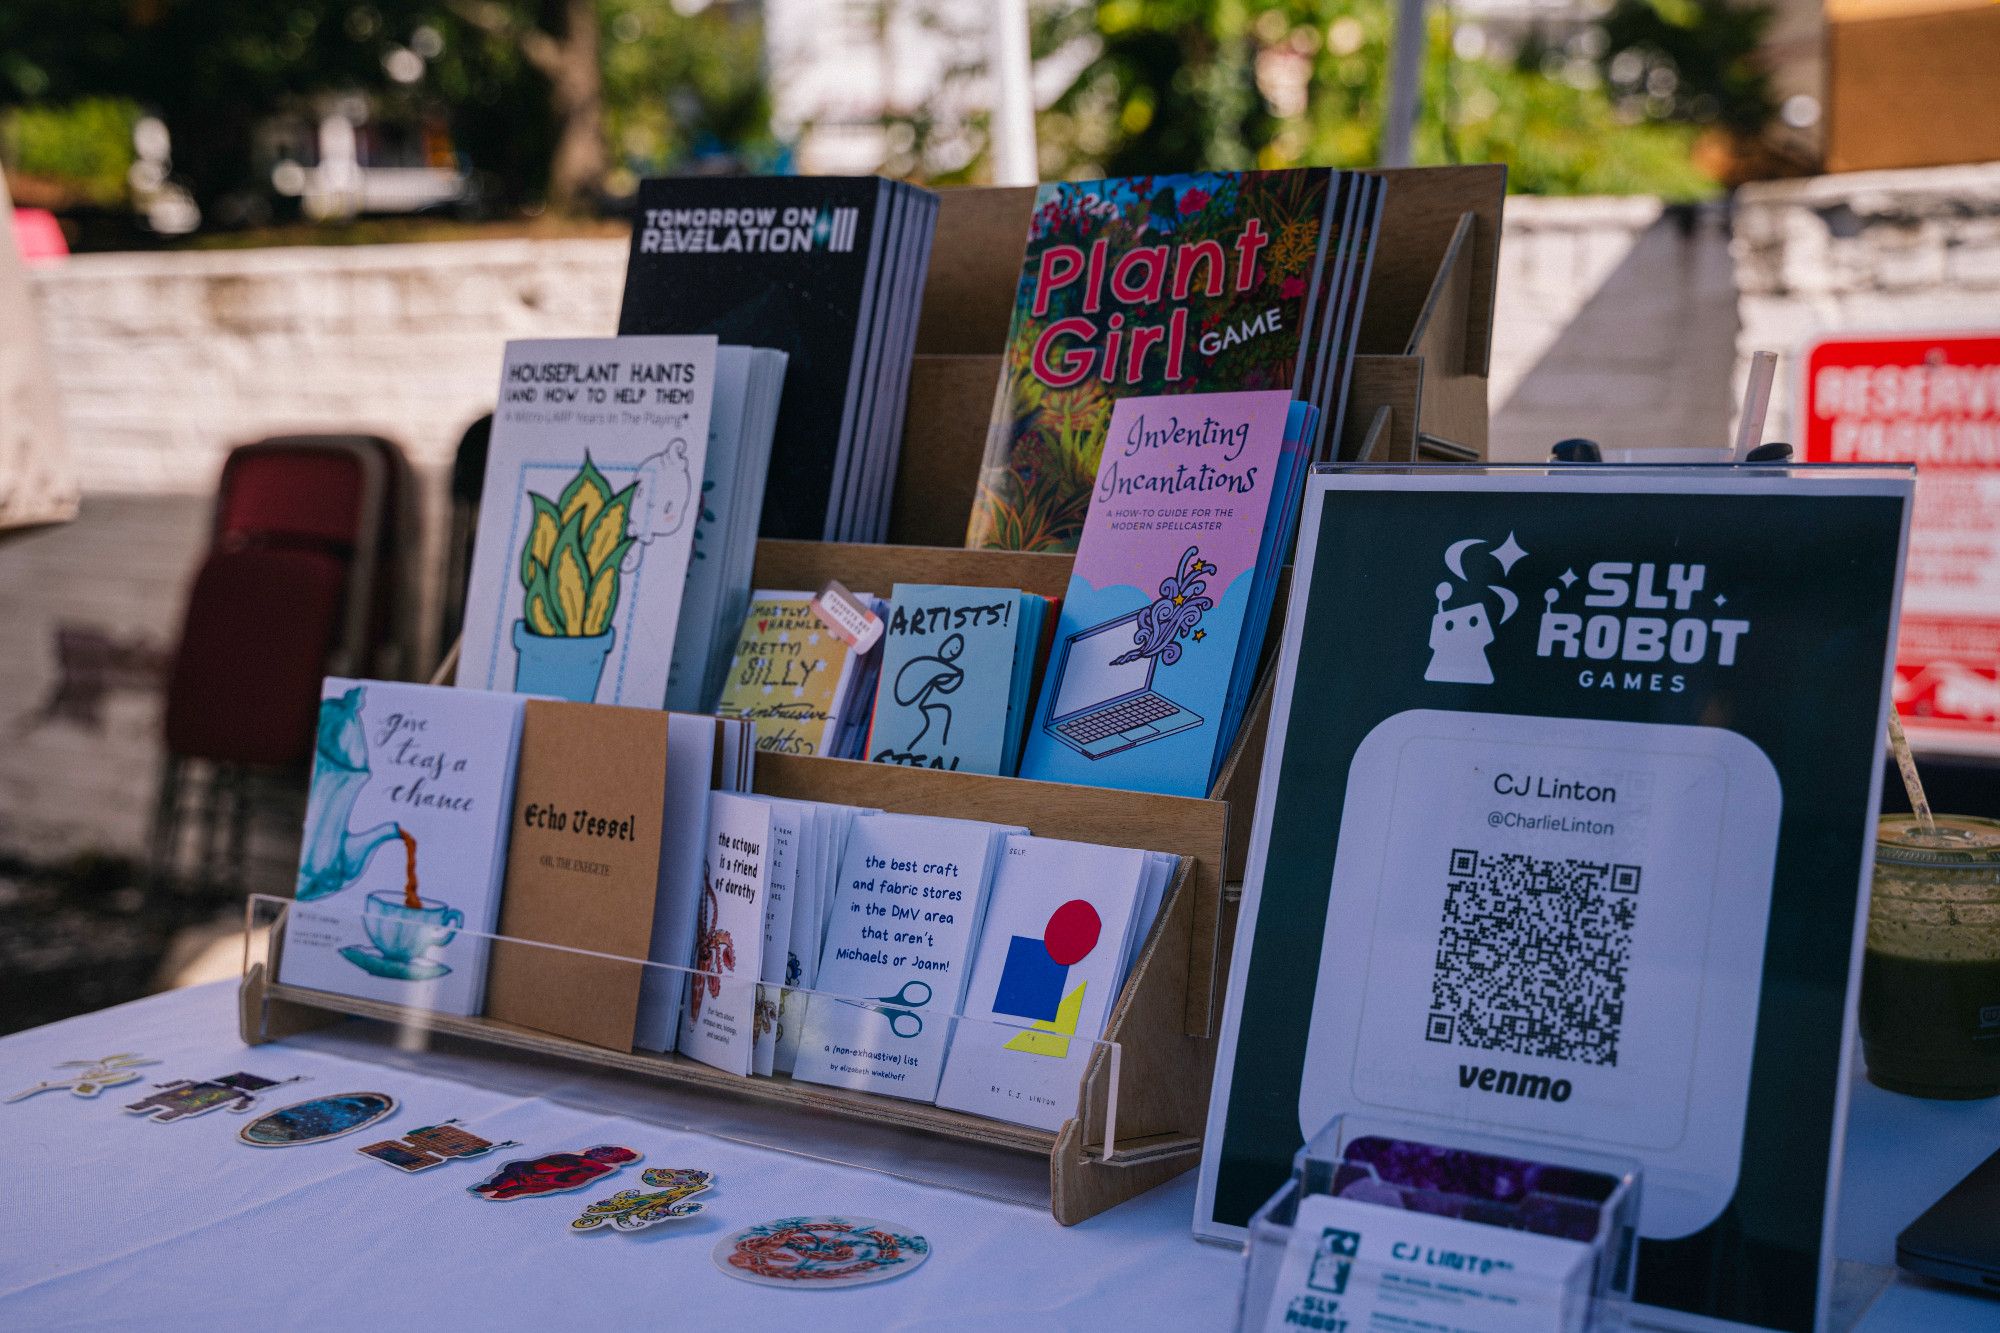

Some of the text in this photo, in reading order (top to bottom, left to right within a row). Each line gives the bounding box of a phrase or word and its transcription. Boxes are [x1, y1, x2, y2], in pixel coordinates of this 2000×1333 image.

[645, 207, 817, 228] TOMORROW ON
[640, 227, 815, 253] REVELATION
[1031, 217, 1269, 317] Plant
[1030, 307, 1284, 388] Girl GAME
[509, 362, 695, 384] HOUSEPLANT HAINTS
[545, 387, 577, 404] HOW
[587, 387, 607, 404] TO
[613, 387, 645, 404] HELP
[1124, 413, 1250, 462] Inventing
[1098, 460, 1258, 503] Incantations
[1105, 508, 1234, 518] A HOW-TO GUIDE FOR THE
[1111, 521, 1223, 531] MODERN SPELLCASTER
[1584, 562, 1706, 611] SLY
[768, 618, 830, 631] HARMLE
[889, 600, 1012, 636] ARTISTS!
[1537, 611, 1750, 667] ROBOT
[740, 656, 819, 687] SILLY
[1578, 669, 1686, 693] GAMES
[453, 758, 468, 773] a
[382, 776, 476, 812] chance
[1493, 772, 1617, 804] CJ Linton
[525, 802, 635, 842] Echo Vessel
[1487, 810, 1616, 837] @CharlieLinton
[718, 832, 760, 858] the octopus
[719, 853, 726, 869] is
[733, 859, 758, 879] friend
[865, 855, 959, 878] the best craft
[715, 878, 756, 905] of dorothy
[852, 878, 962, 901] and fabric stores
[850, 902, 955, 925] in the DMV area
[861, 925, 934, 947] that aren't
[835, 947, 950, 973] Michaels or Joann!
[824, 1045, 919, 1067] a (non-exhaustive) list
[830, 1063, 839, 1071] by
[1459, 1064, 1573, 1103] venmo
[1391, 1241, 1421, 1262] CJ
[1303, 1295, 1339, 1314] SLY
